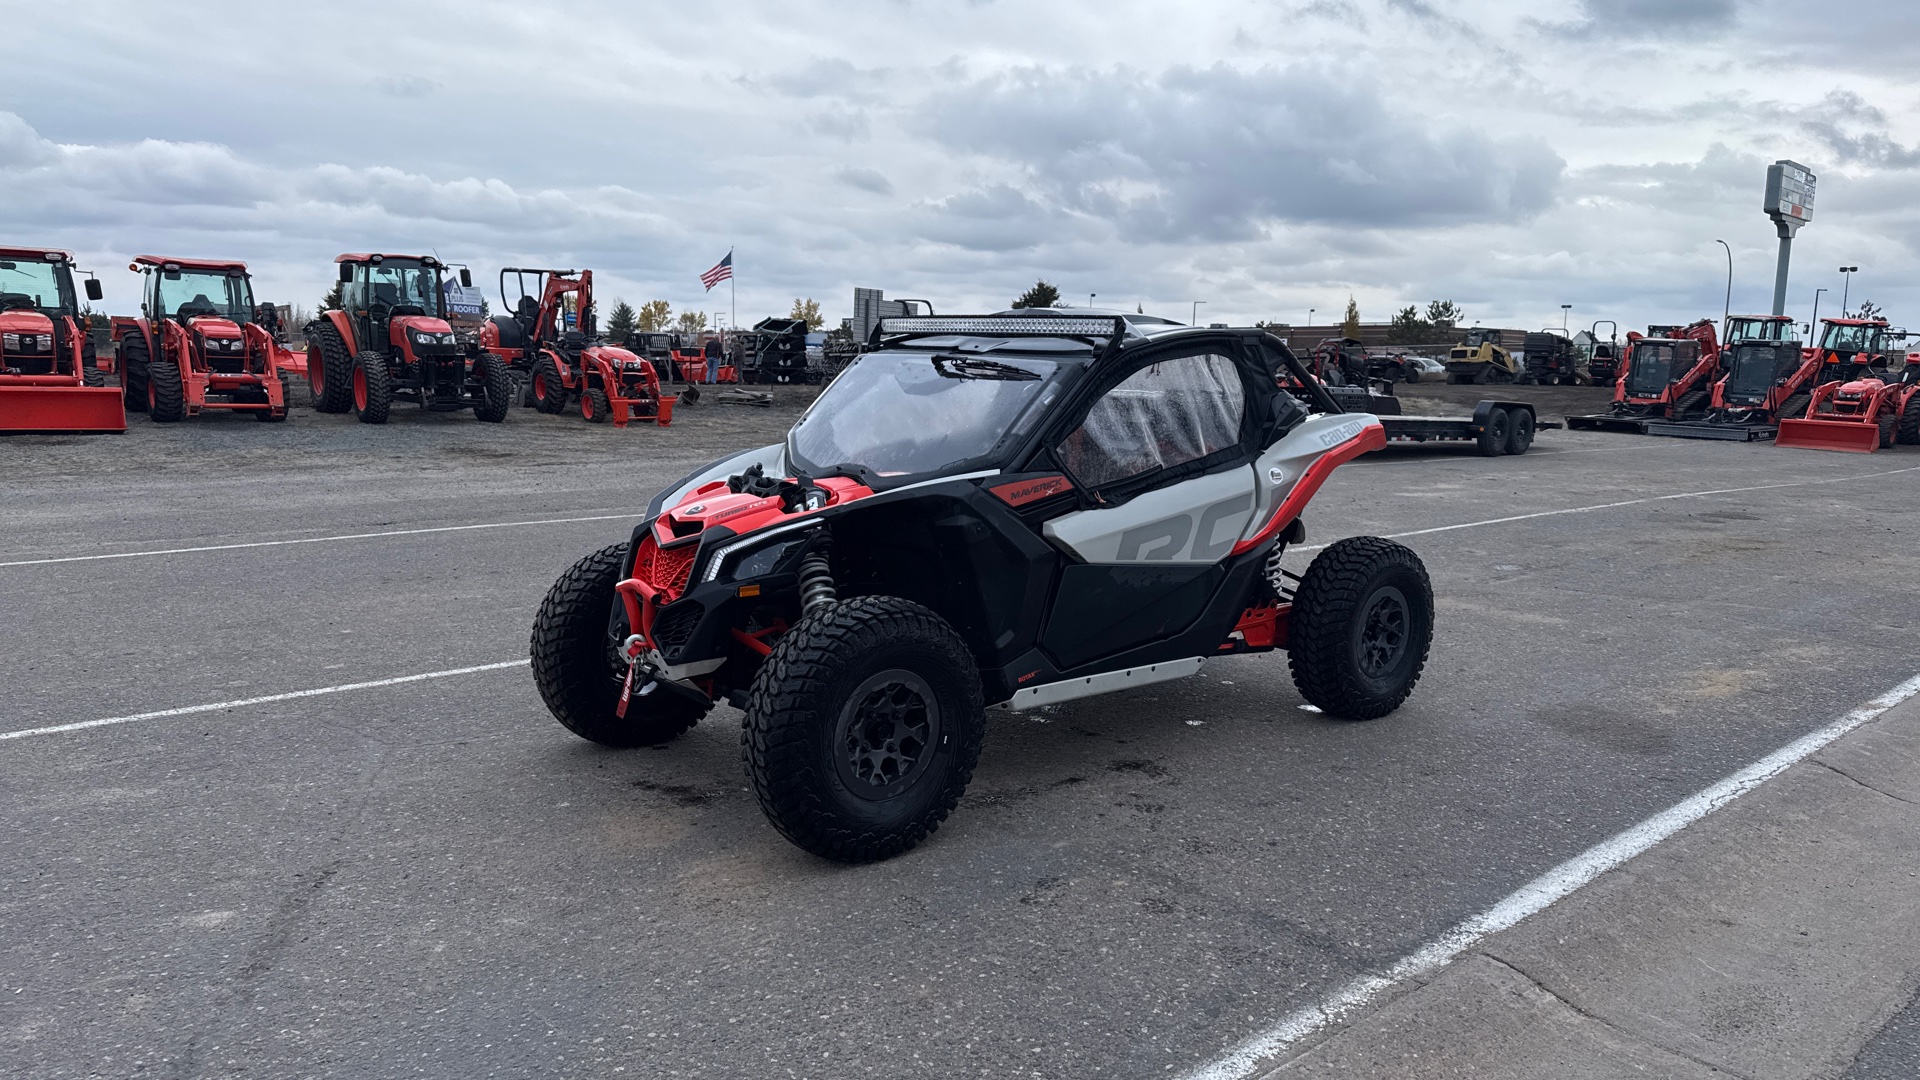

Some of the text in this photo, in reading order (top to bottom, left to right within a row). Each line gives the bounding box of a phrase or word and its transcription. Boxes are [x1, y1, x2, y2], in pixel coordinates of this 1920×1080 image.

[451, 295, 464, 303] PLUS
[453, 305, 480, 314] ROOFER
[1319, 421, 1363, 446] can-am
[1010, 478, 1062, 500] MAVERICK
[713, 505, 748, 520] TURBO
[1115, 492, 1253, 561] RC
[1017, 671, 1037, 683] ROTAX
